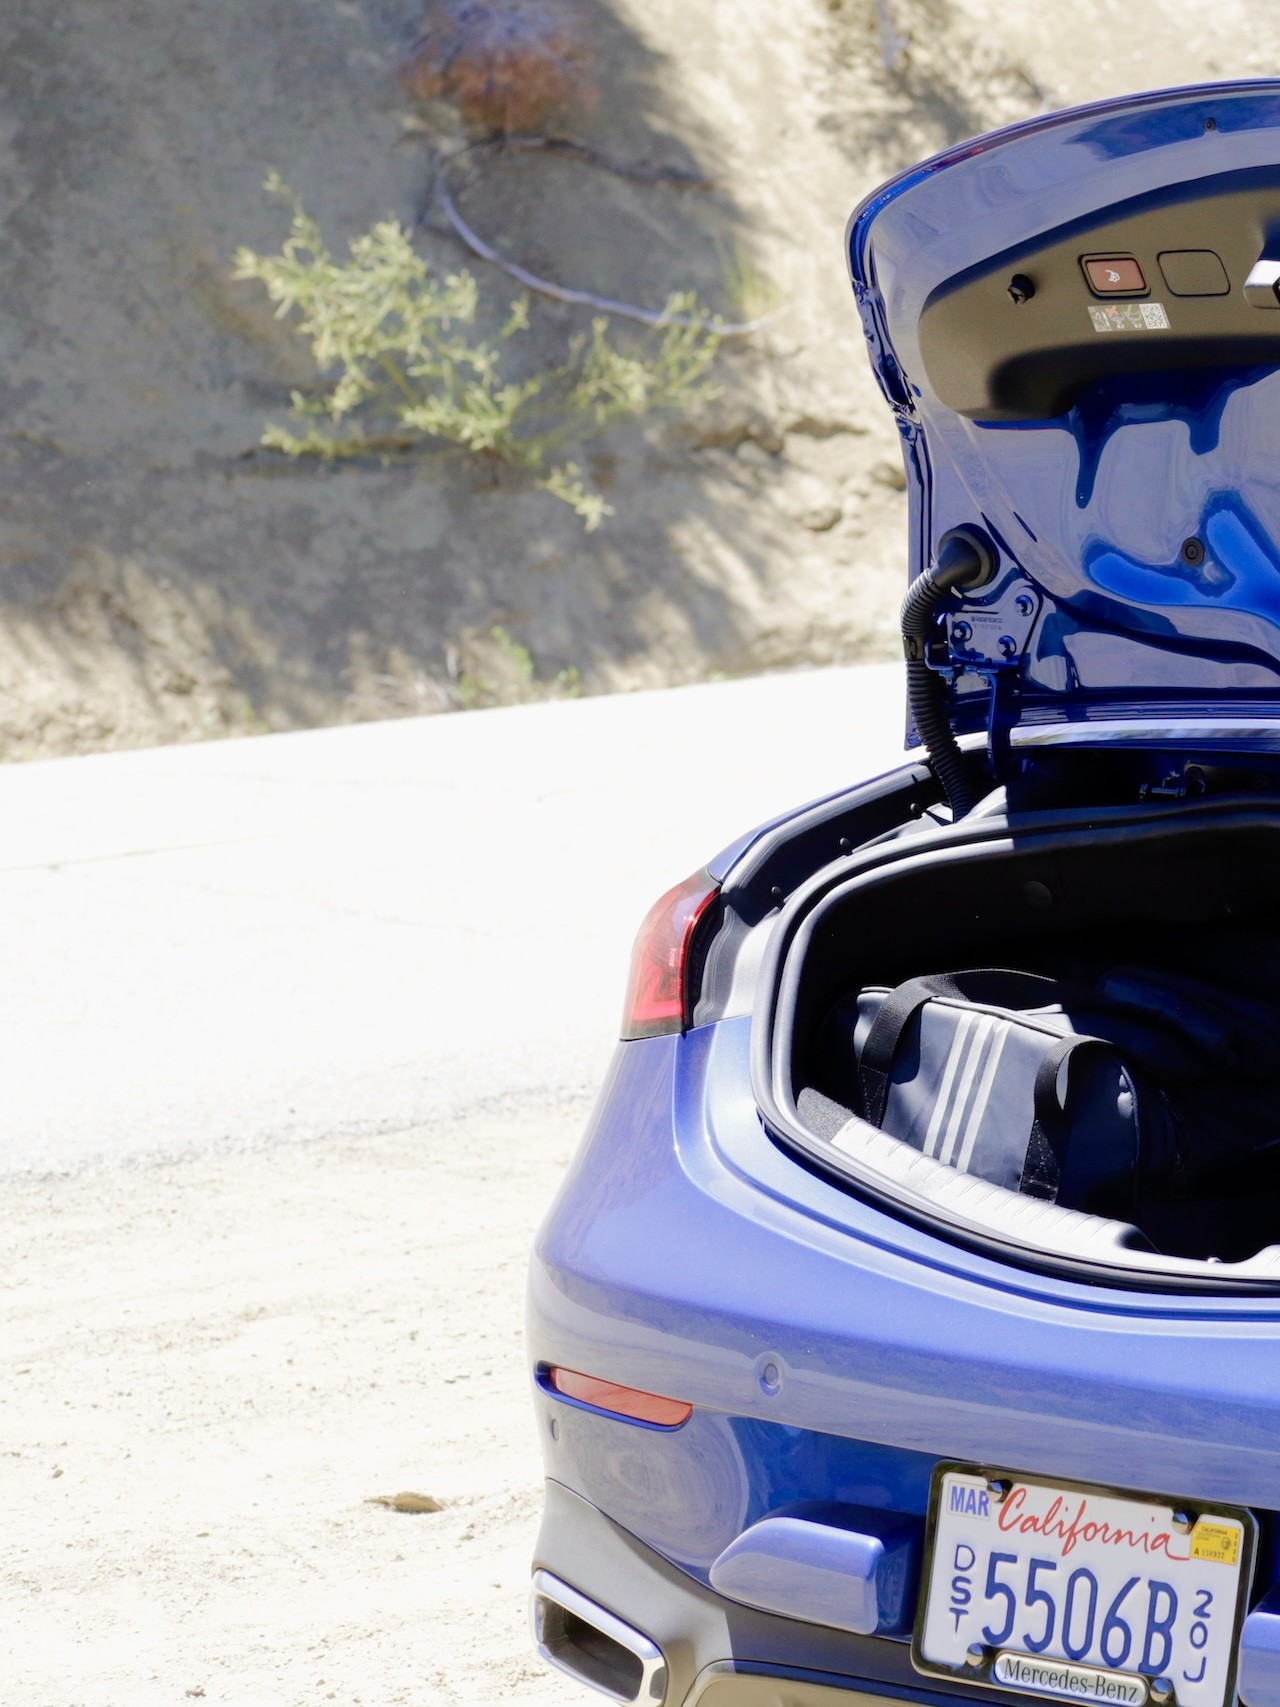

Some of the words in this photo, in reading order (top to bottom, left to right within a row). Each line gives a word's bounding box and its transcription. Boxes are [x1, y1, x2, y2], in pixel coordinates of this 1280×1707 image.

[951, 1486, 990, 1517] MAR
[998, 1488, 1190, 1560] California
[982, 1552, 1178, 1676] 5506B
[1004, 1658, 1138, 1703] Mercedes-Benz
